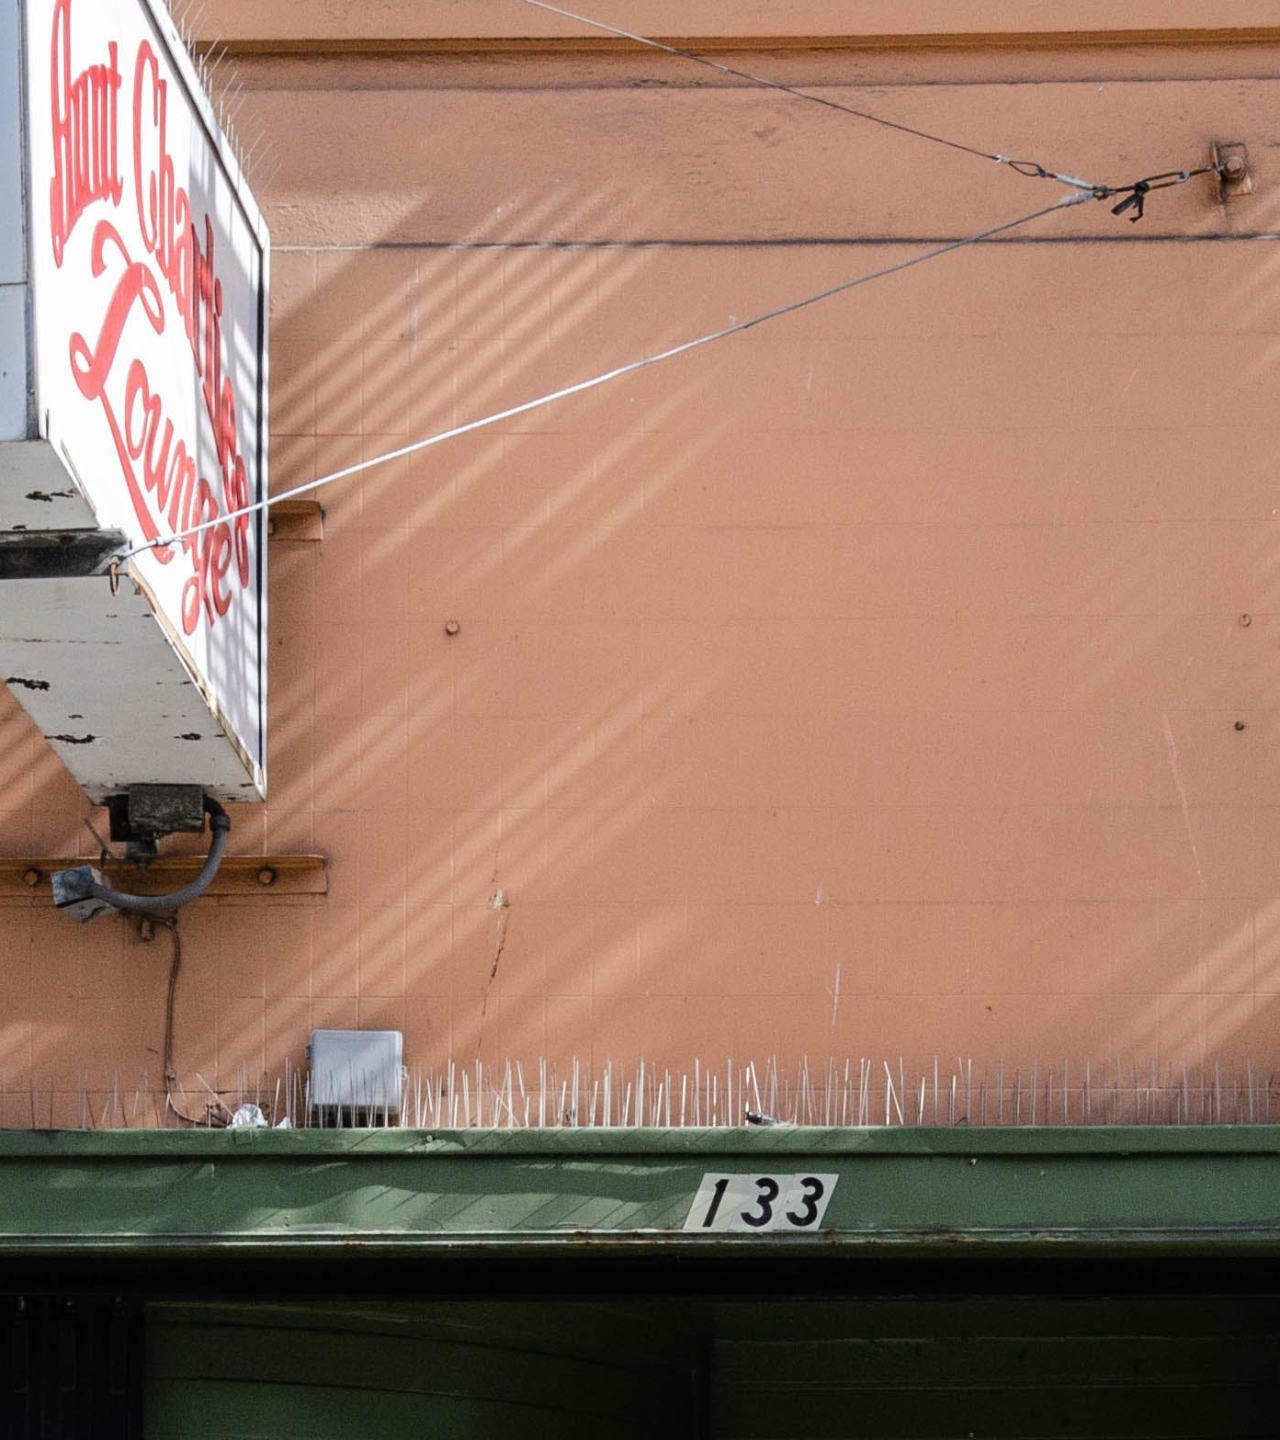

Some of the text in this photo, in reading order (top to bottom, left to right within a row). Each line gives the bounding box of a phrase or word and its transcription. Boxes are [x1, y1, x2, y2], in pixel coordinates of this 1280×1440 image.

[49, 0, 123, 270] Aunt
[70, 219, 233, 636] Lounge
[702, 1176, 824, 1228] 133
